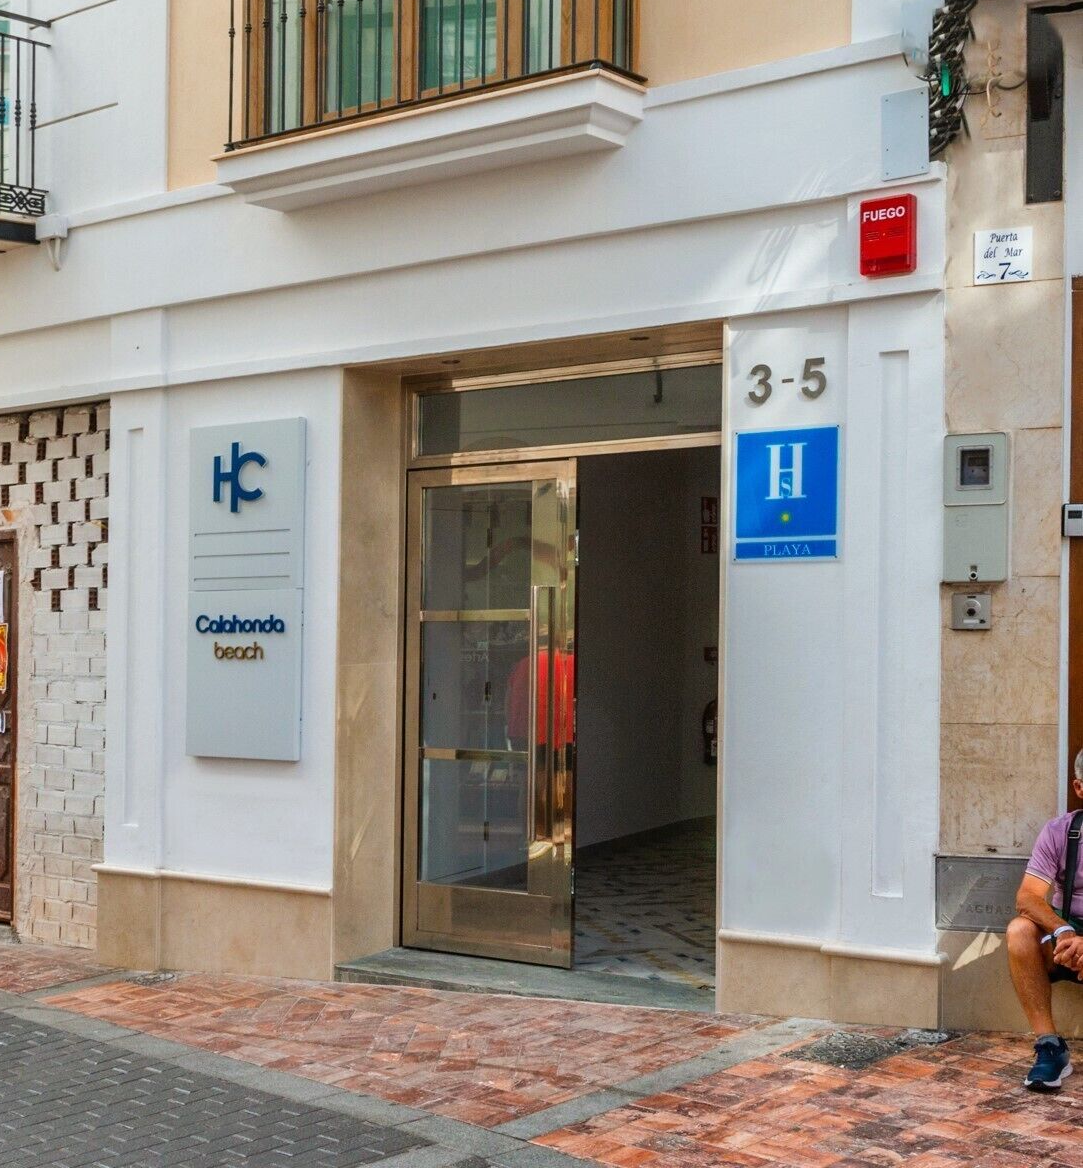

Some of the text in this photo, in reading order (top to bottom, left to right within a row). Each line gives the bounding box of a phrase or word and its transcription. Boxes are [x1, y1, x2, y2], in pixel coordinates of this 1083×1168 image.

[862, 205, 906, 223] FUEGO
[989, 232, 1019, 243] Puerta
[983, 246, 1024, 259] del Mar
[998, 262, 1012, 280] 7
[763, 543, 812, 556] PLAYA
[195, 614, 286, 634] Calahonda
[214, 642, 264, 660] beach
